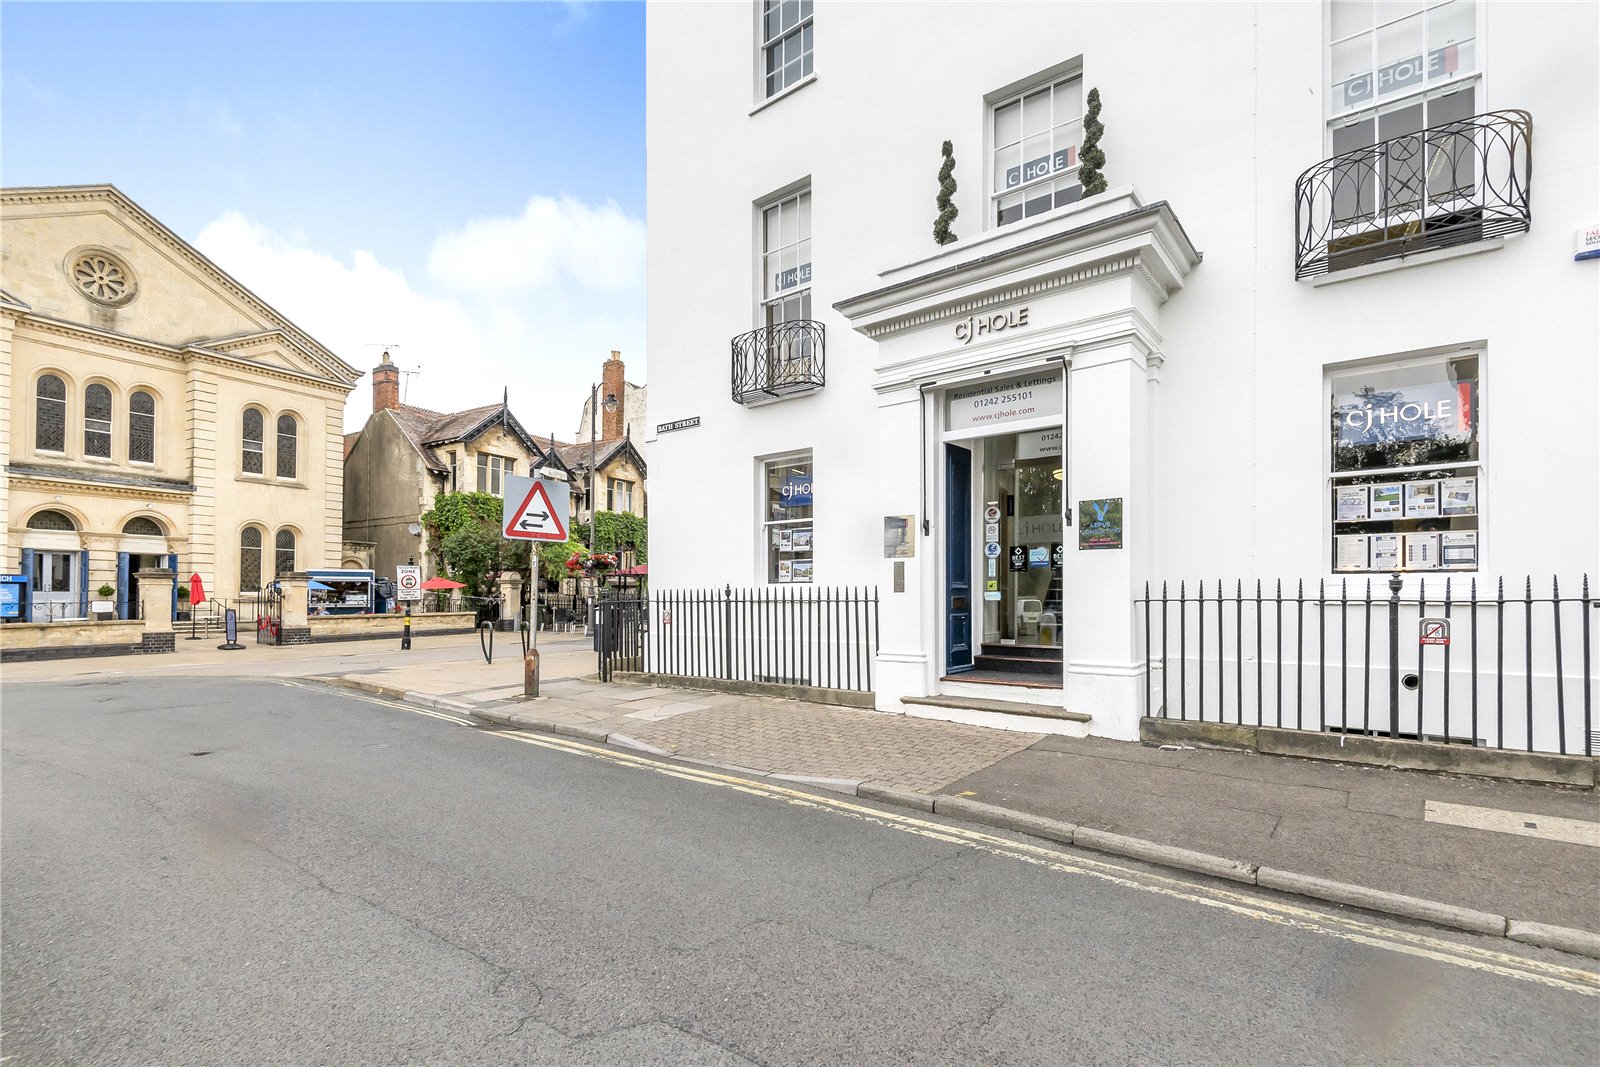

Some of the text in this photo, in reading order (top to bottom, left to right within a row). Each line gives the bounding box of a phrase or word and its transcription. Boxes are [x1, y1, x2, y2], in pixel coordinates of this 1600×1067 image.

[1379, 53, 1440, 87] HOLE
[787, 267, 811, 284] HOLE
[954, 307, 1029, 345] cj HOLE
[953, 387, 993, 400] Residential
[995, 383, 1014, 393] Sales
[1024, 376, 1057, 387] Lettings
[974, 391, 1033, 408] 01242 255101
[972, 406, 1036, 422] www.cjhole.com
[1346, 399, 1452, 434] cj HOLE
[657, 418, 699, 432] BATH STREET
[1041, 433, 1062, 441] 01242
[782, 482, 793, 501] cj
